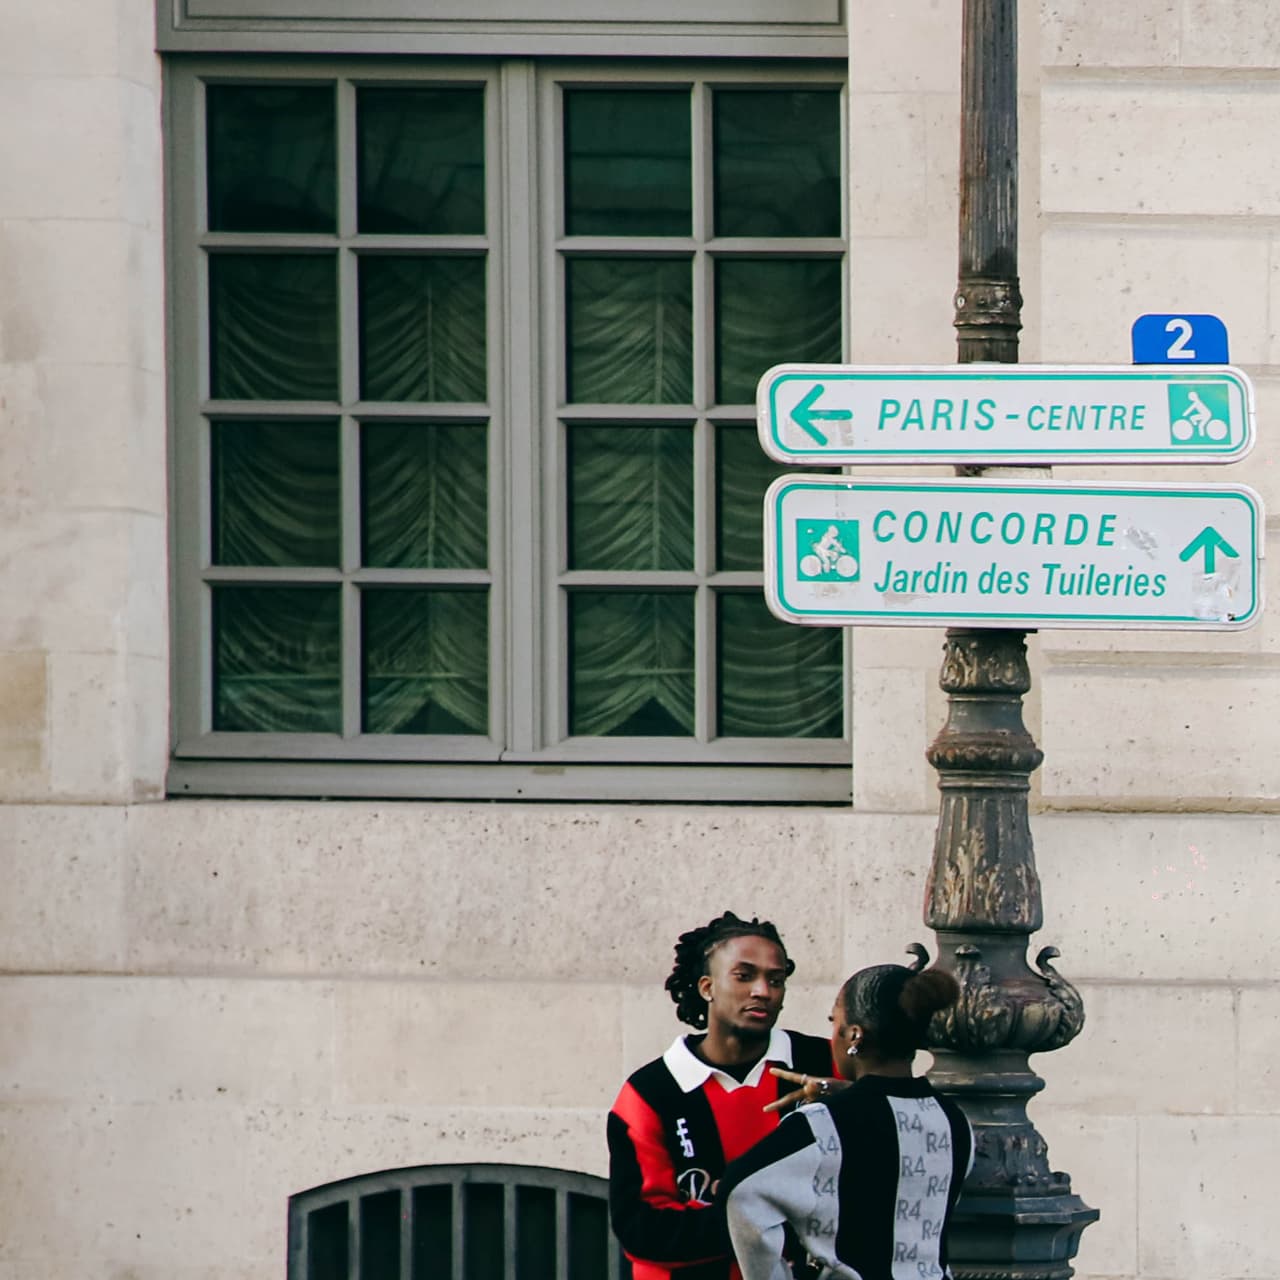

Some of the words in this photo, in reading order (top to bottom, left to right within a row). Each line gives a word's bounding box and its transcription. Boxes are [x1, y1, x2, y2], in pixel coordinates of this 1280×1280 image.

[1166, 318, 1195, 359] 2
[872, 510, 1117, 546] CONCORDE
[874, 560, 968, 594] Jardin
[977, 562, 1030, 595] des
[1042, 563, 1167, 597] Tuileries
[897, 1111, 923, 1133] R4
[926, 1131, 950, 1153] R4
[901, 1155, 926, 1177] R4
[927, 1174, 948, 1197] R4
[896, 1199, 921, 1220] R4
[806, 1216, 835, 1238] R4
[922, 1219, 942, 1241] R4
[895, 1241, 919, 1262] R4
